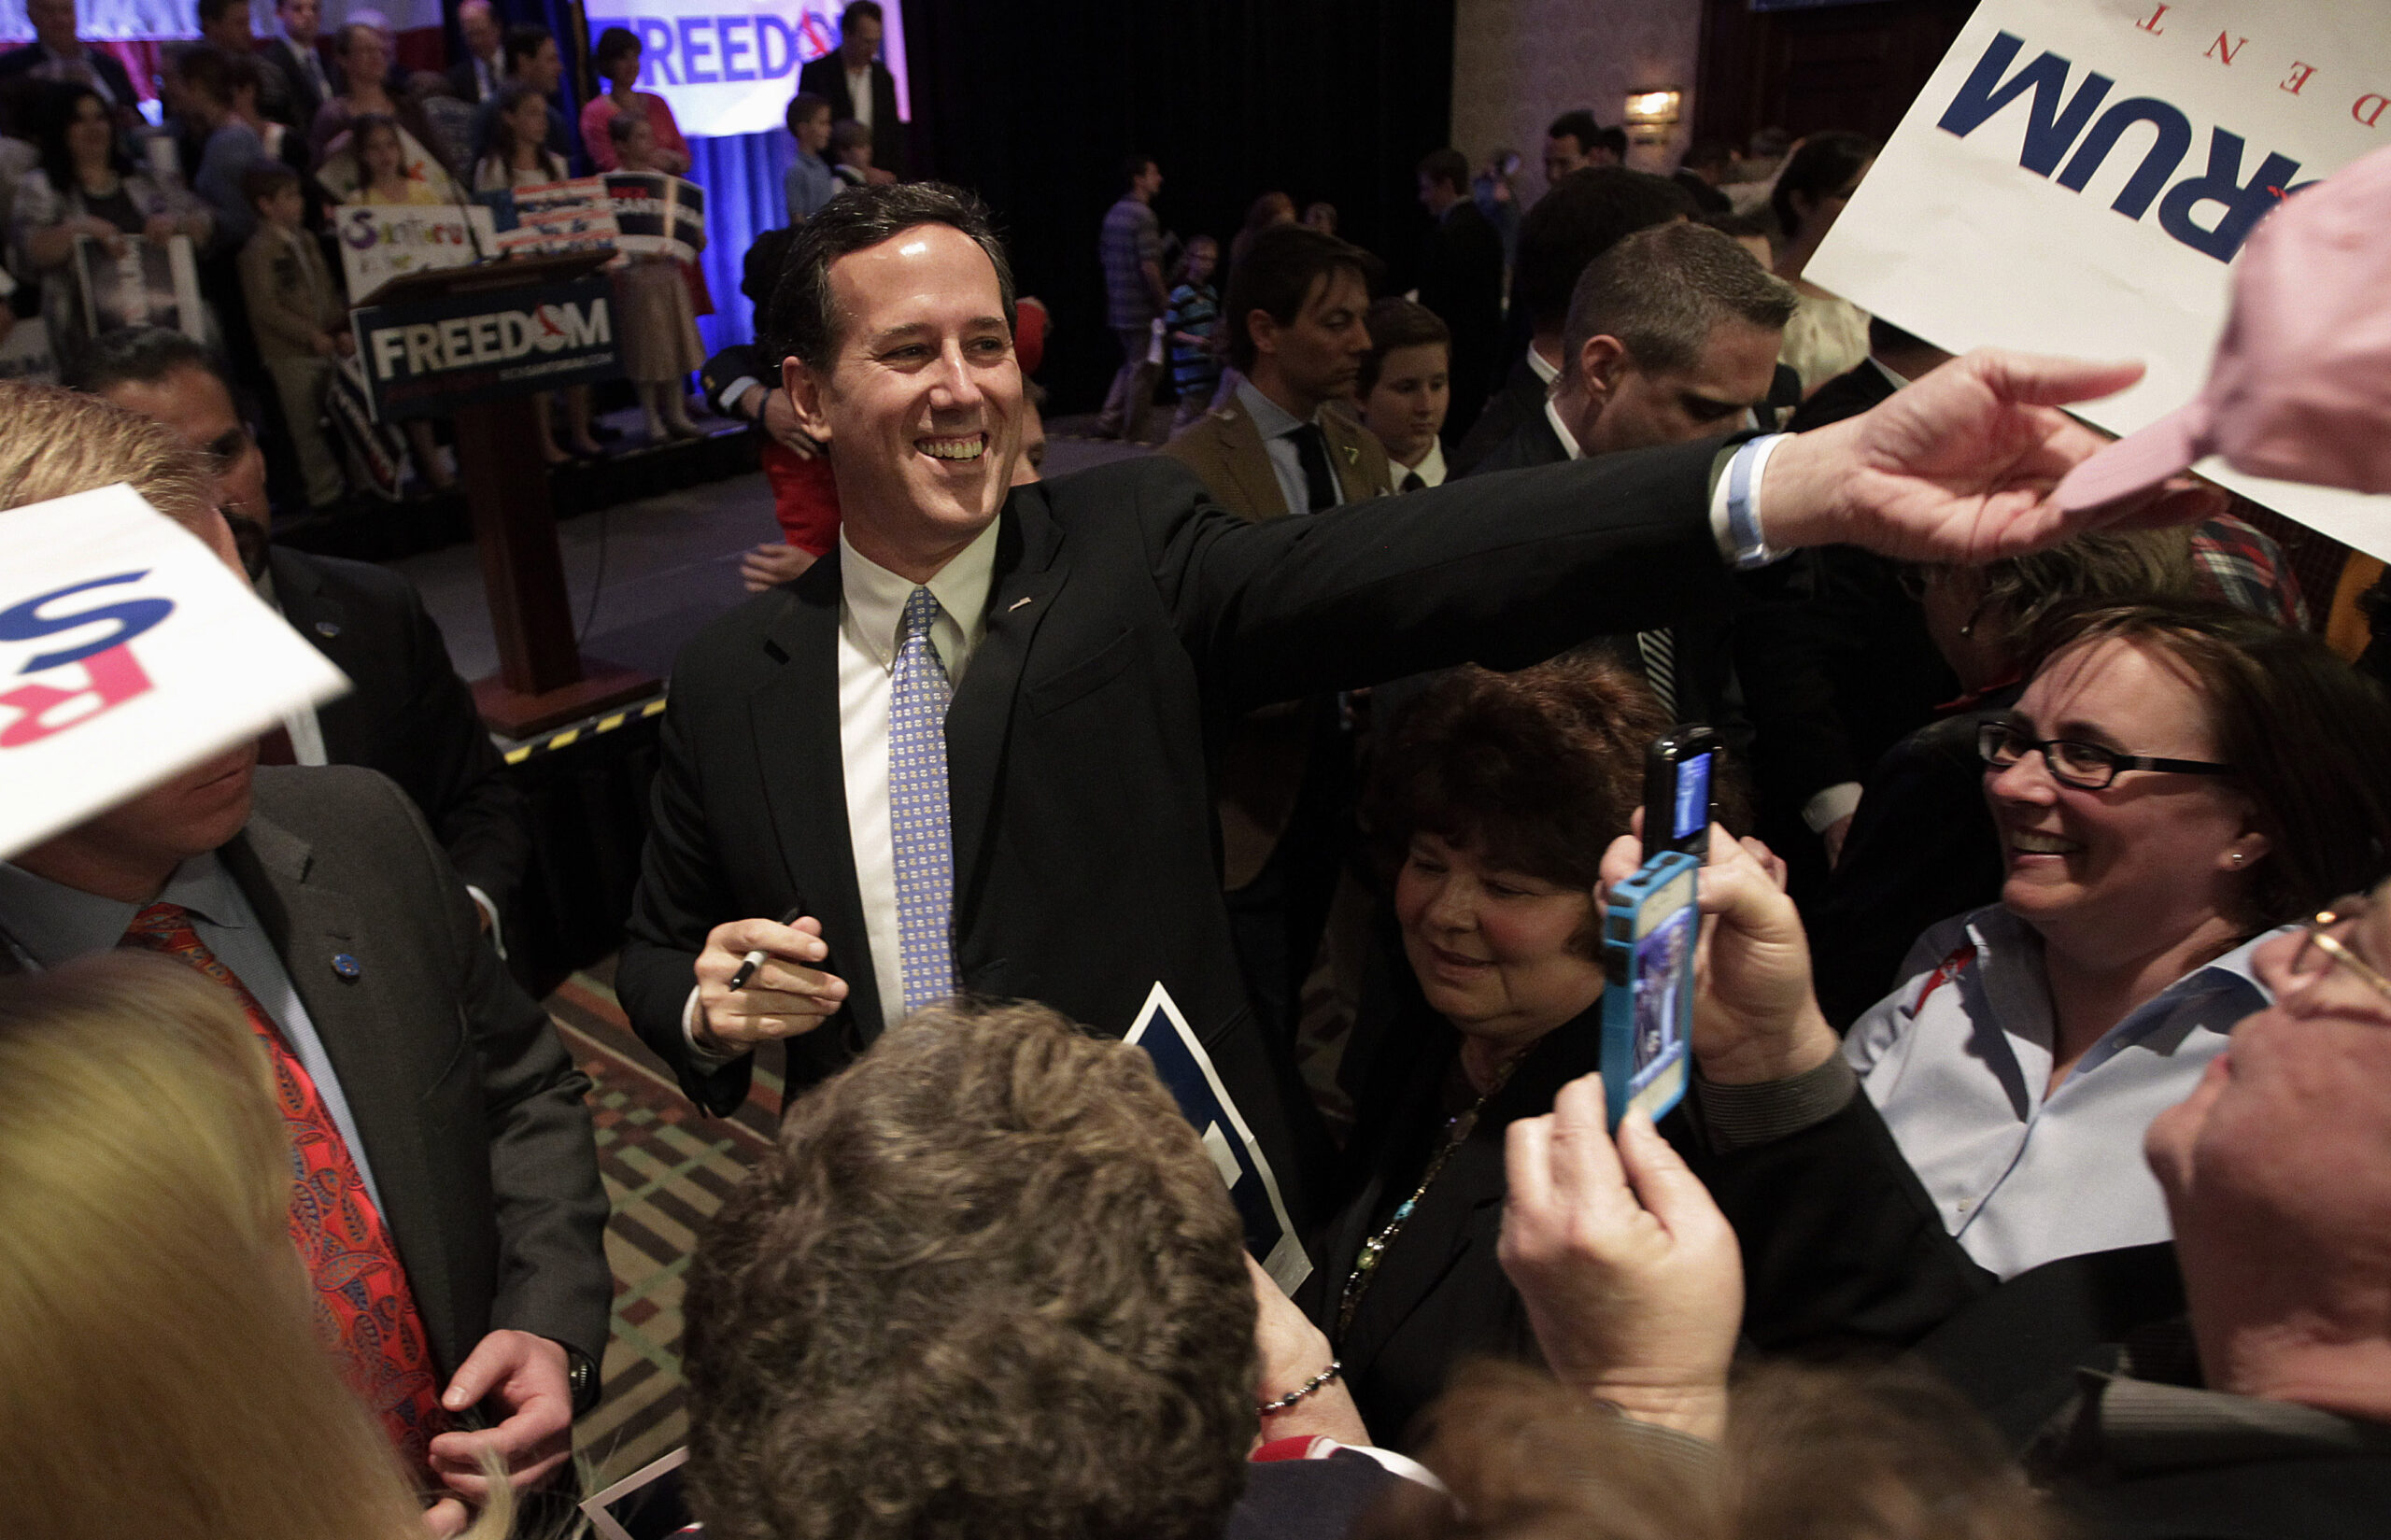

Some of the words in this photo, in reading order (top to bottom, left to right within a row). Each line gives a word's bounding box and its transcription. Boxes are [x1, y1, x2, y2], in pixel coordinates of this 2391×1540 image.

[2135, 4, 2391, 128] DENT
[1936, 29, 2326, 264] RUM
[370, 298, 613, 381] FREEDOM
